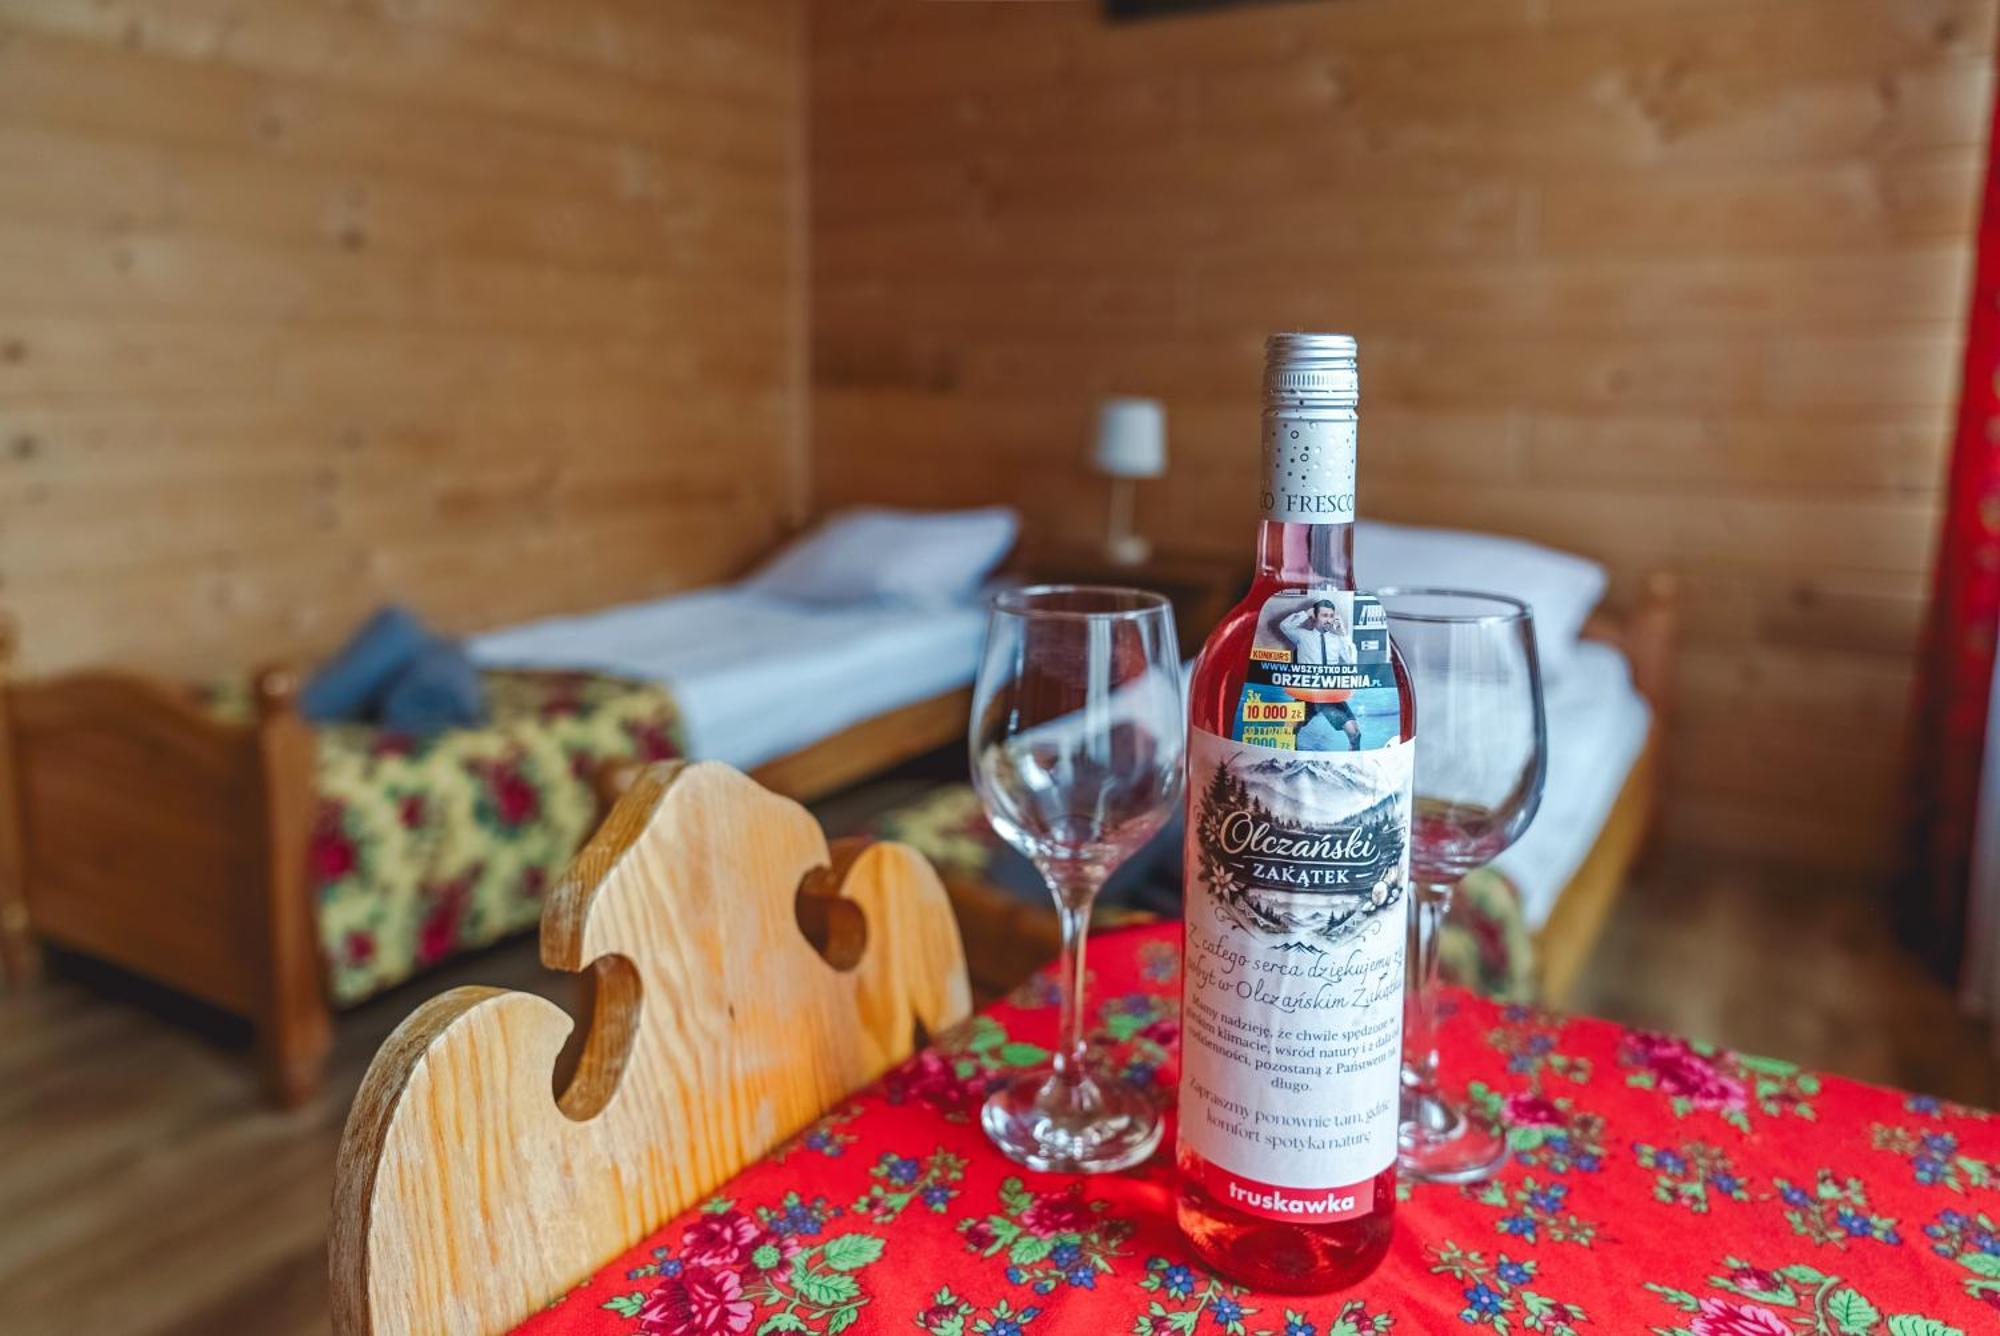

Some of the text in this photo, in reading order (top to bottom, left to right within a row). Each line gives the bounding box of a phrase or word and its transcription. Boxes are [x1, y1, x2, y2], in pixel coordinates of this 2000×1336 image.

[1287, 494, 1354, 513] FRESCO
[1252, 650, 1289, 662] KONKURS
[1342, 666, 1358, 674] DLA
[1247, 705, 1260, 719] 10
[1263, 705, 1288, 719] 000
[1220, 811, 1380, 862] Olczański
[1202, 934, 1249, 974] całego
[1252, 959, 1303, 977] serca
[1308, 949, 1391, 985] dziękujemy
[1219, 979, 1234, 991] w
[1237, 979, 1349, 1014] Olczańskim
[1221, 1014, 1273, 1038] nadzieję,
[1278, 1027, 1292, 1040] że
[1296, 1029, 1338, 1042] chwile
[1342, 1020, 1388, 1042] spędzone
[1218, 1026, 1271, 1055] klimacie,
[1275, 1046, 1315, 1058] wśród
[1320, 1046, 1358, 1059] natury
[1255, 1059, 1321, 1077] pozostaną
[1326, 1066, 1332, 1075] z
[1337, 1054, 1386, 1074] Państwem
[1271, 1077, 1312, 1093] długo.
[1207, 1107, 1371, 1152] komfort spotyka naturę
[1255, 1110, 1332, 1128] ponownie
[1335, 1113, 1364, 1127] tam,
[1229, 1182, 1355, 1214] truskawka
